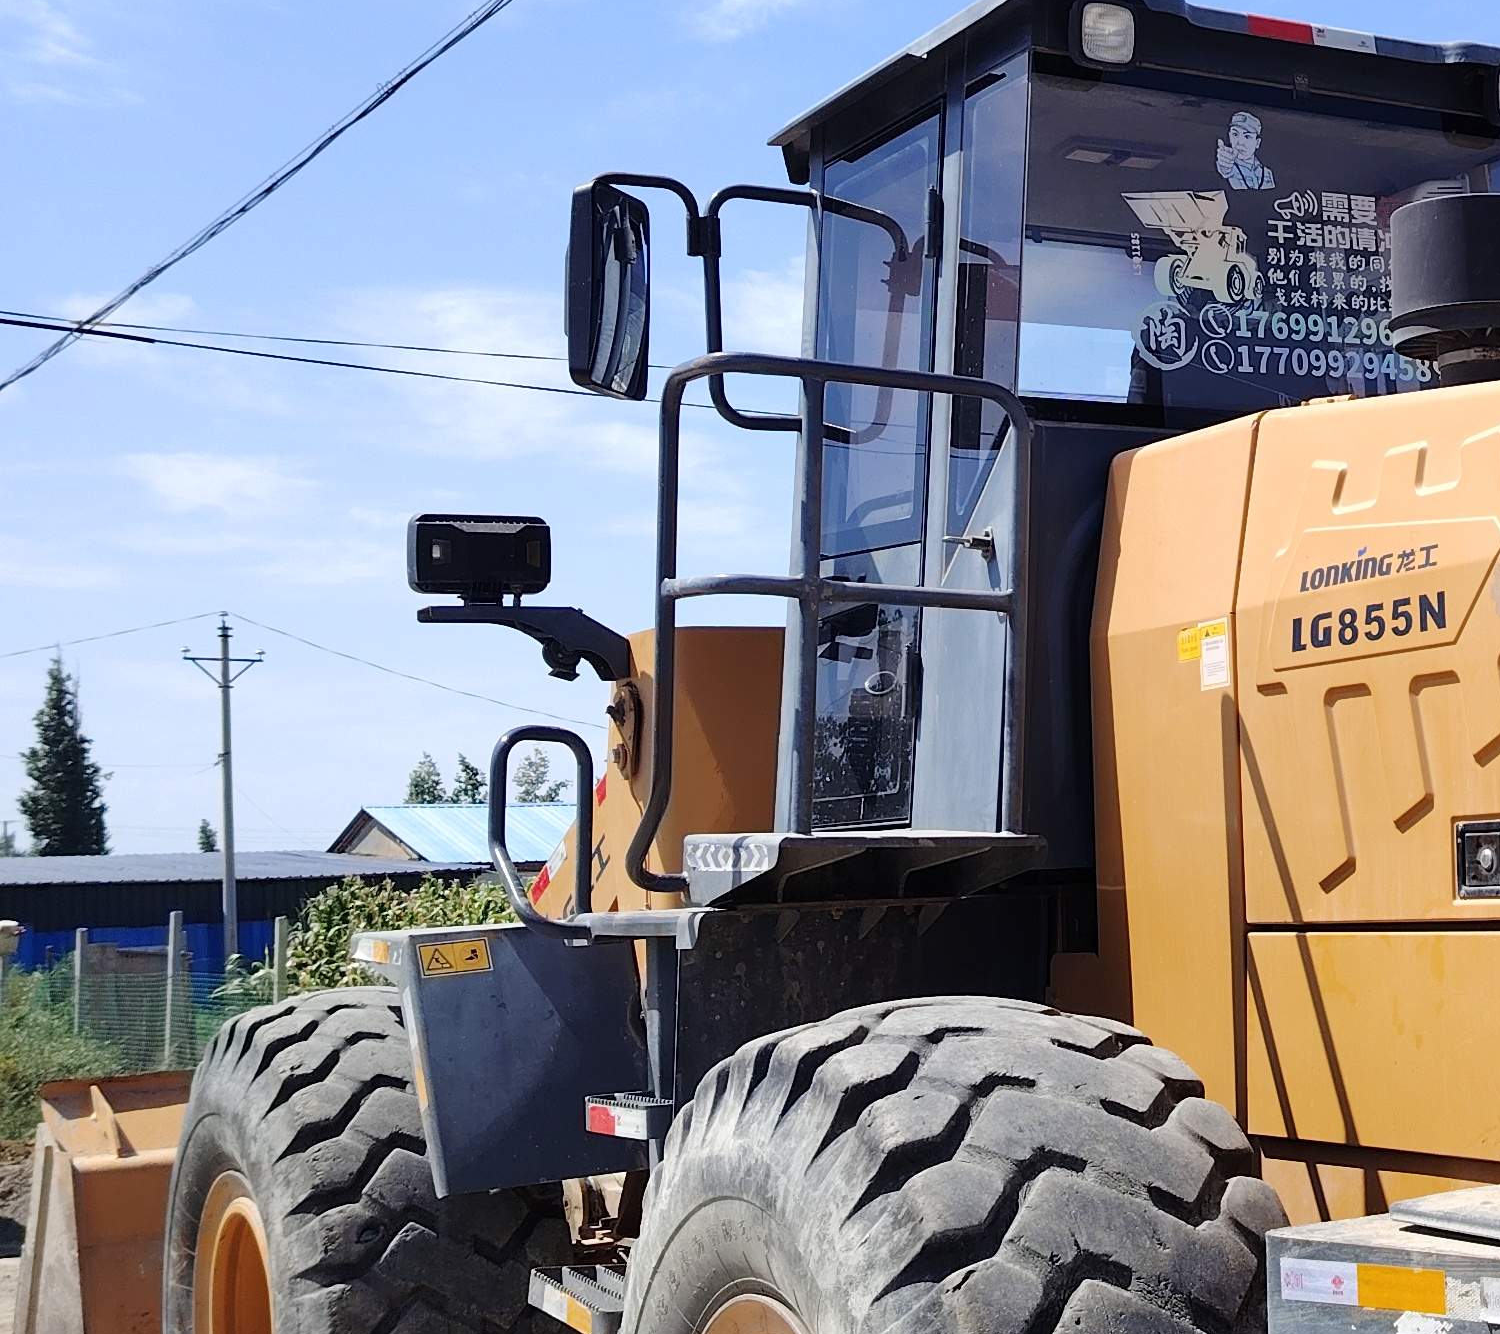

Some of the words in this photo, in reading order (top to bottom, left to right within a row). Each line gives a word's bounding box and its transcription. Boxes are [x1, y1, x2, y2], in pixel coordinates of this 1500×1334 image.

[1321, 192, 1377, 225] 需要
[1267, 247, 1391, 273] 别为难我的同
[1148, 307, 1187, 358] 陶
[1396, 543, 1438, 573] 龙工
[1291, 591, 1447, 652] LG855N
